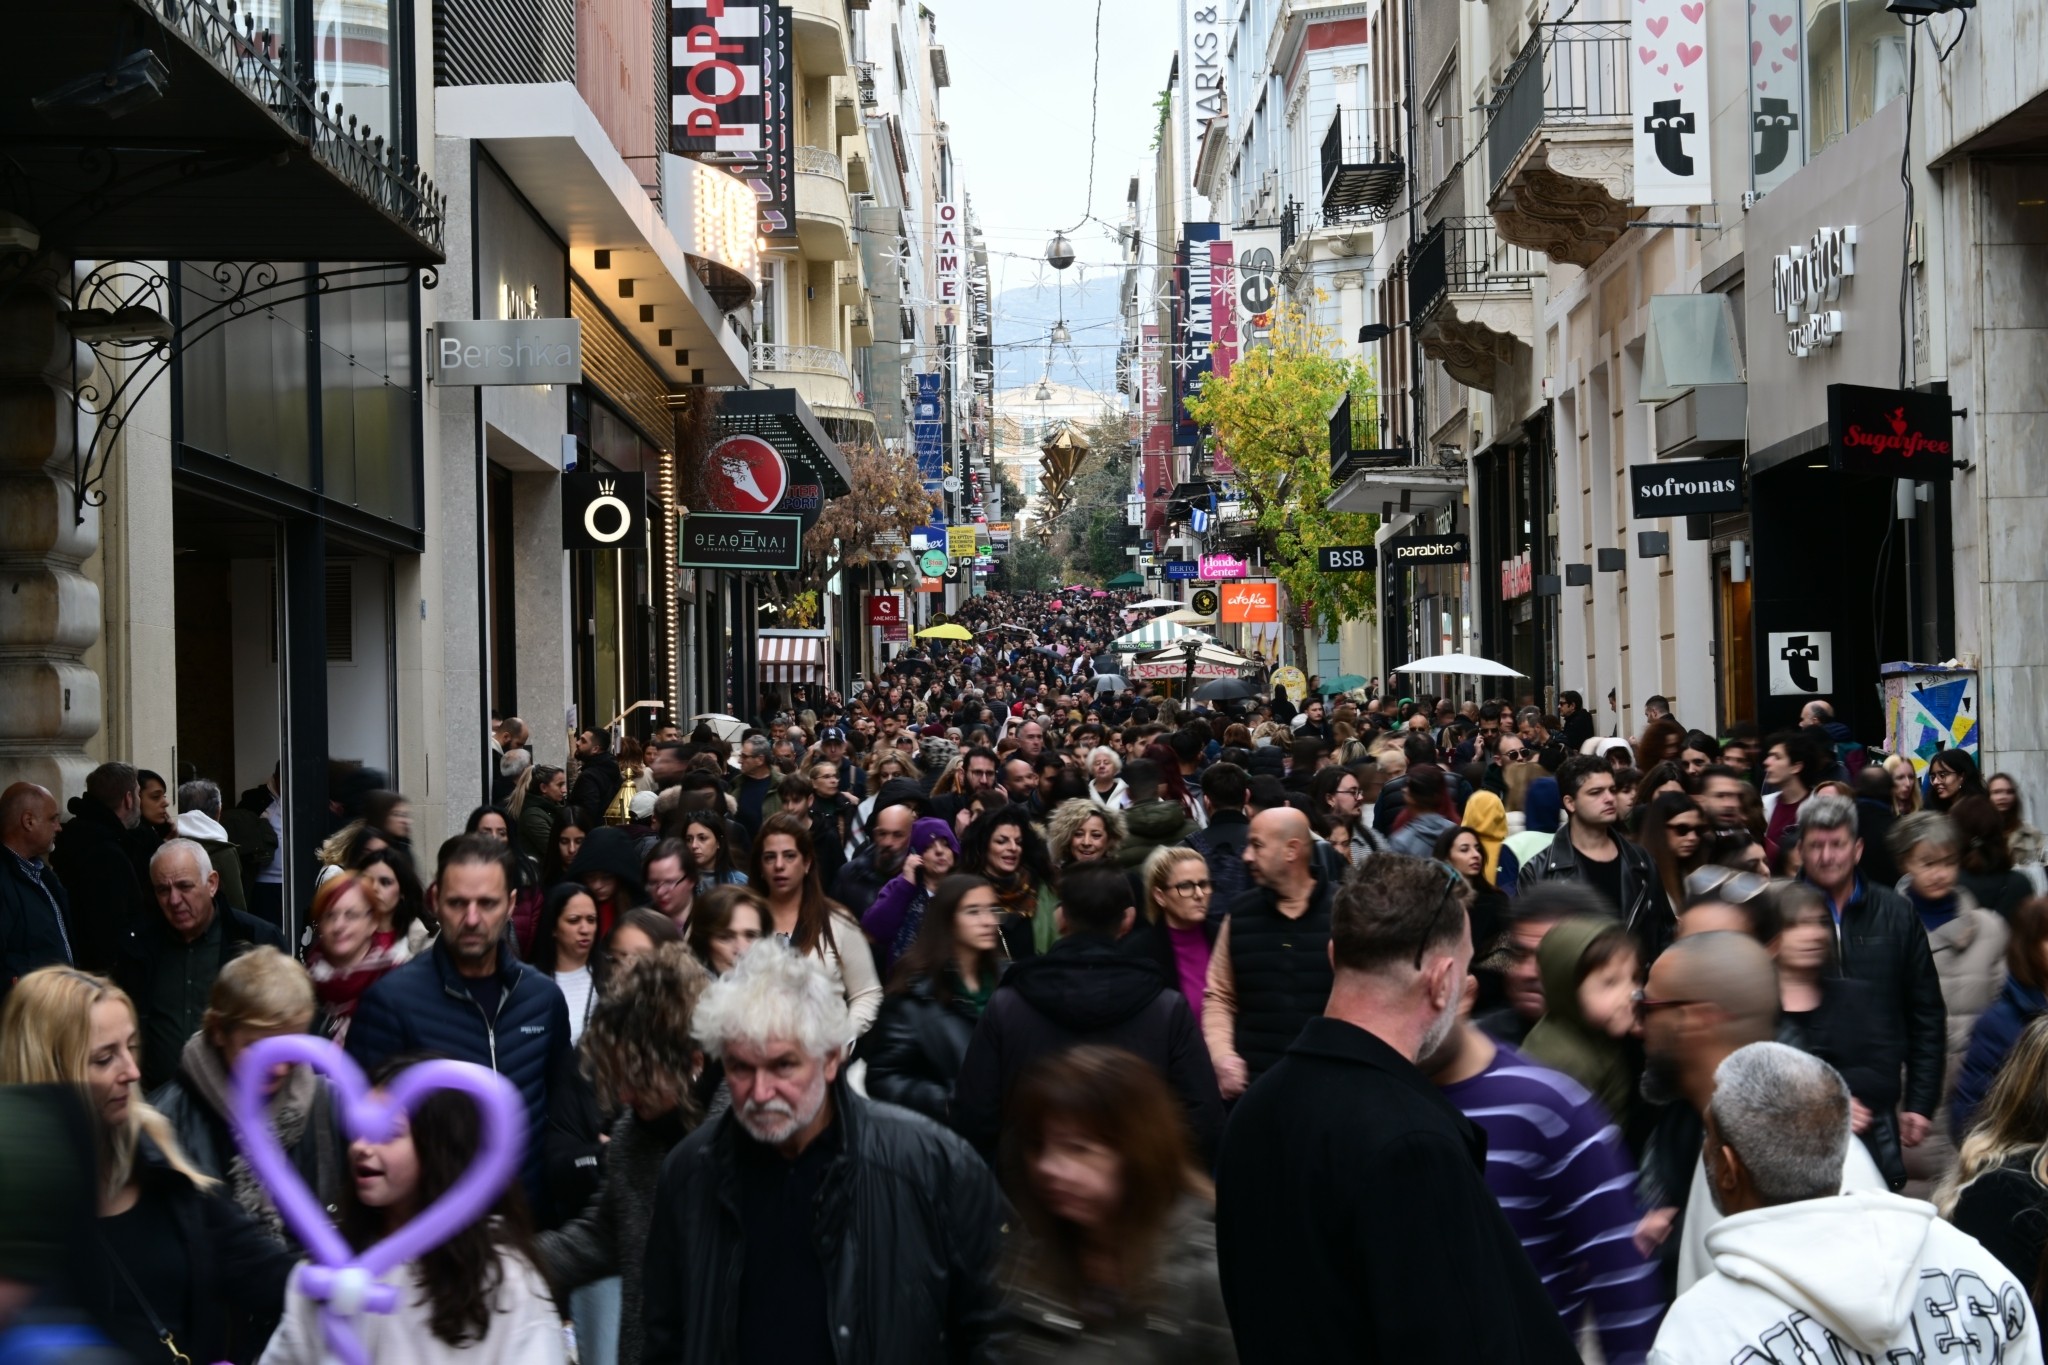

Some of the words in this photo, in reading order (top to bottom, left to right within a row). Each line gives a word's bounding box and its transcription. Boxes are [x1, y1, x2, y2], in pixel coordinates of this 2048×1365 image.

[1189, 240, 1212, 297] DUNK
[440, 336, 572, 369] Bershka
[1844, 425, 1950, 458] Sugarfree
[1640, 474, 1736, 500] sofronas
[1329, 550, 1365, 568] BSB
[1397, 543, 1454, 559] parabita
[1203, 567, 1239, 577] Center
